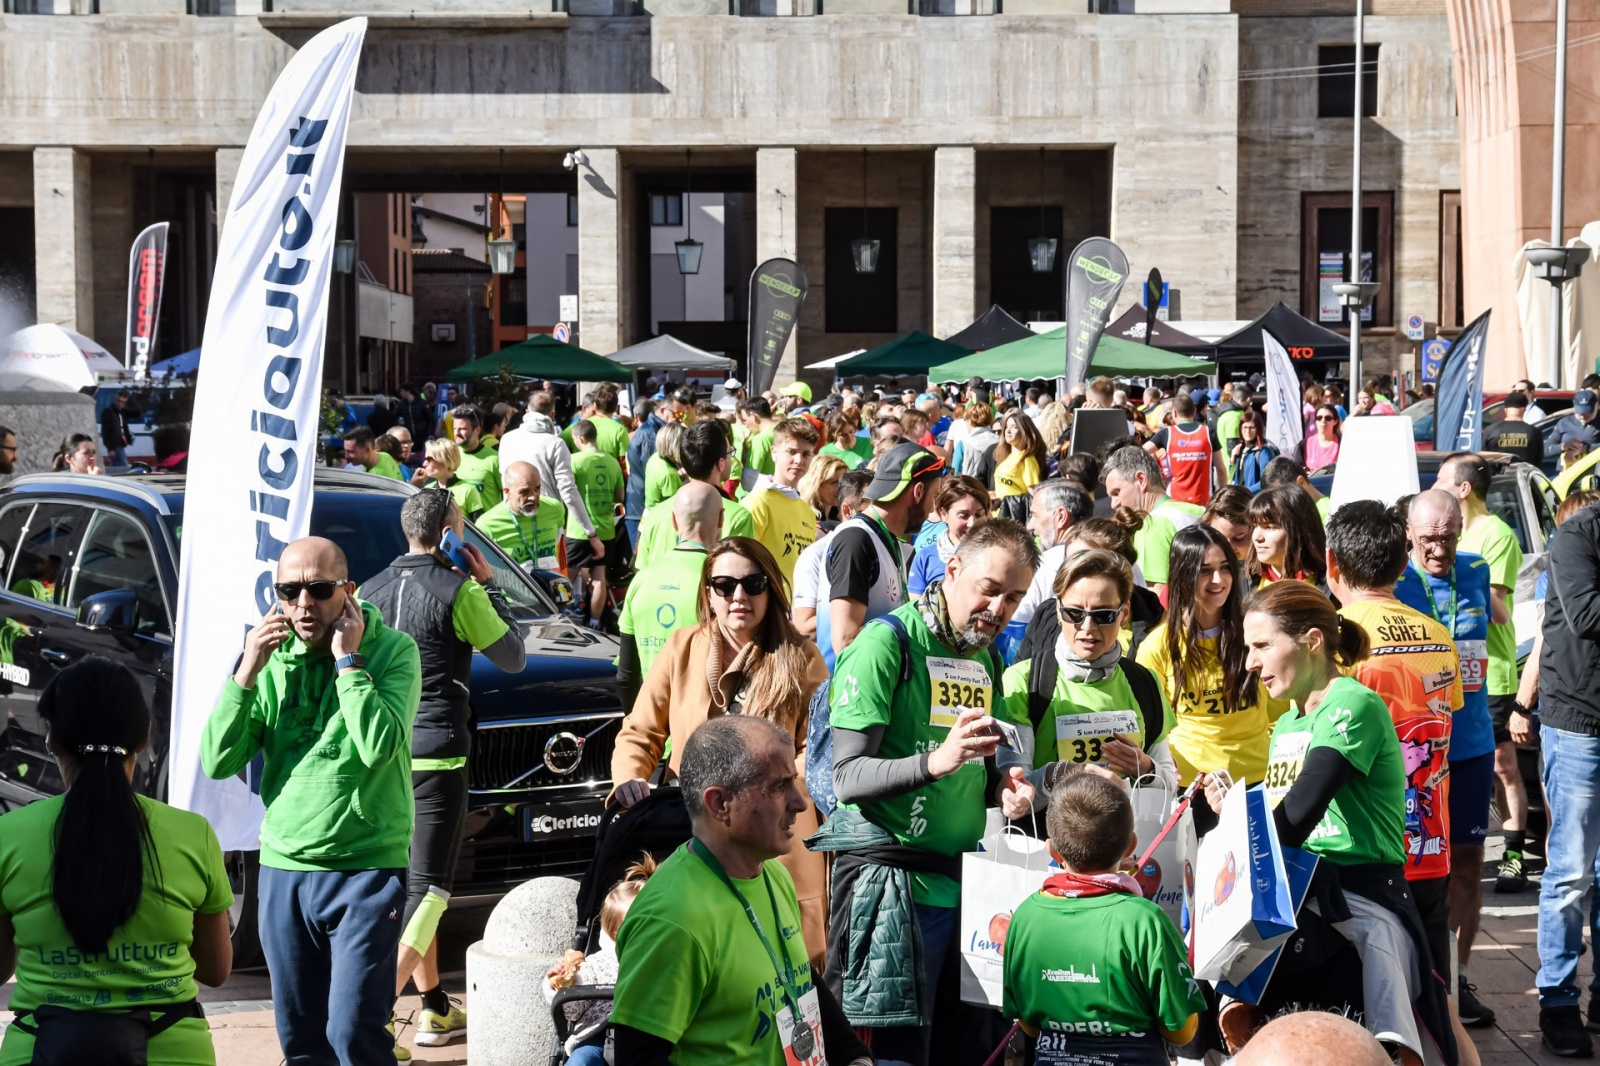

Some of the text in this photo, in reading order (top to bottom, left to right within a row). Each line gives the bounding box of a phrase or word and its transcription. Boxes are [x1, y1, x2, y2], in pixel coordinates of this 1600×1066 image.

[938, 681, 985, 708] 3326
[1093, 727, 1112, 735] Family
[1071, 736, 1116, 764] 33
[970, 930, 1002, 954] I am
[52, 970, 81, 980] Digital
[84, 968, 127, 979] Dentistry
[47, 993, 91, 1005] Beccaria
